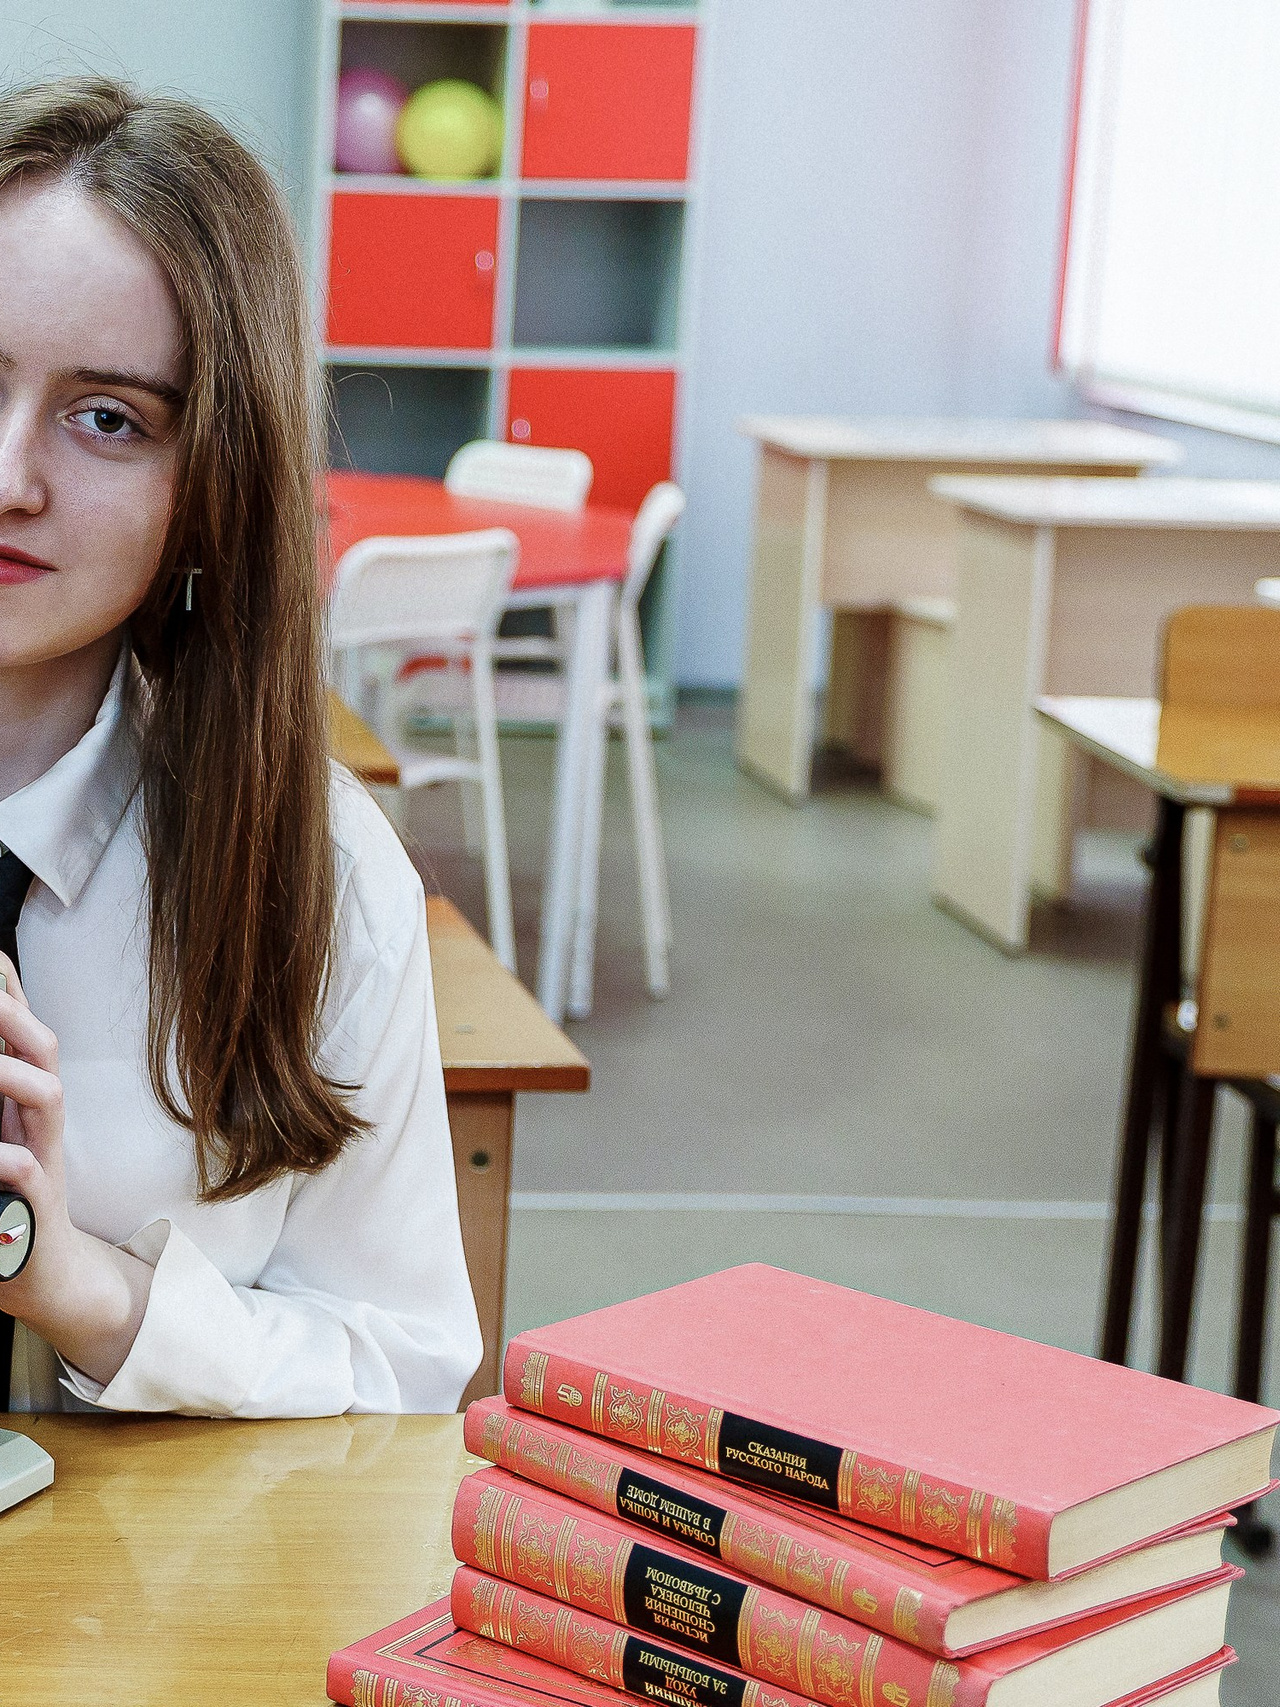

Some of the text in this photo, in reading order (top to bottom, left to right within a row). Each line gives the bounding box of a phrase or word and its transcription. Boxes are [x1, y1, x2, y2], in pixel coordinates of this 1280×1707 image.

[725, 1446, 830, 1490] РУССКОГО НАРОДА
[748, 1441, 808, 1469] СКАЗАНИЯ
[619, 1496, 716, 1547] СОБАКА И КОШКА
[626, 1484, 711, 1530] В ВАШЕМ ДОМЕ
[645, 1566, 721, 1605] С ДЬЯВОЛОМ
[650, 1583, 711, 1618] ЧЕЛОВЕКА
[645, 1596, 716, 1633] СНОШЕНИЙ
[653, 1613, 709, 1643] ИСТОРИЯ
[638, 1651, 728, 1695] ЗА БОЛЬНЫМИ
[665, 1675, 698, 1698] УХОД
[644, 1681, 708, 1707] МАШНИЙ
